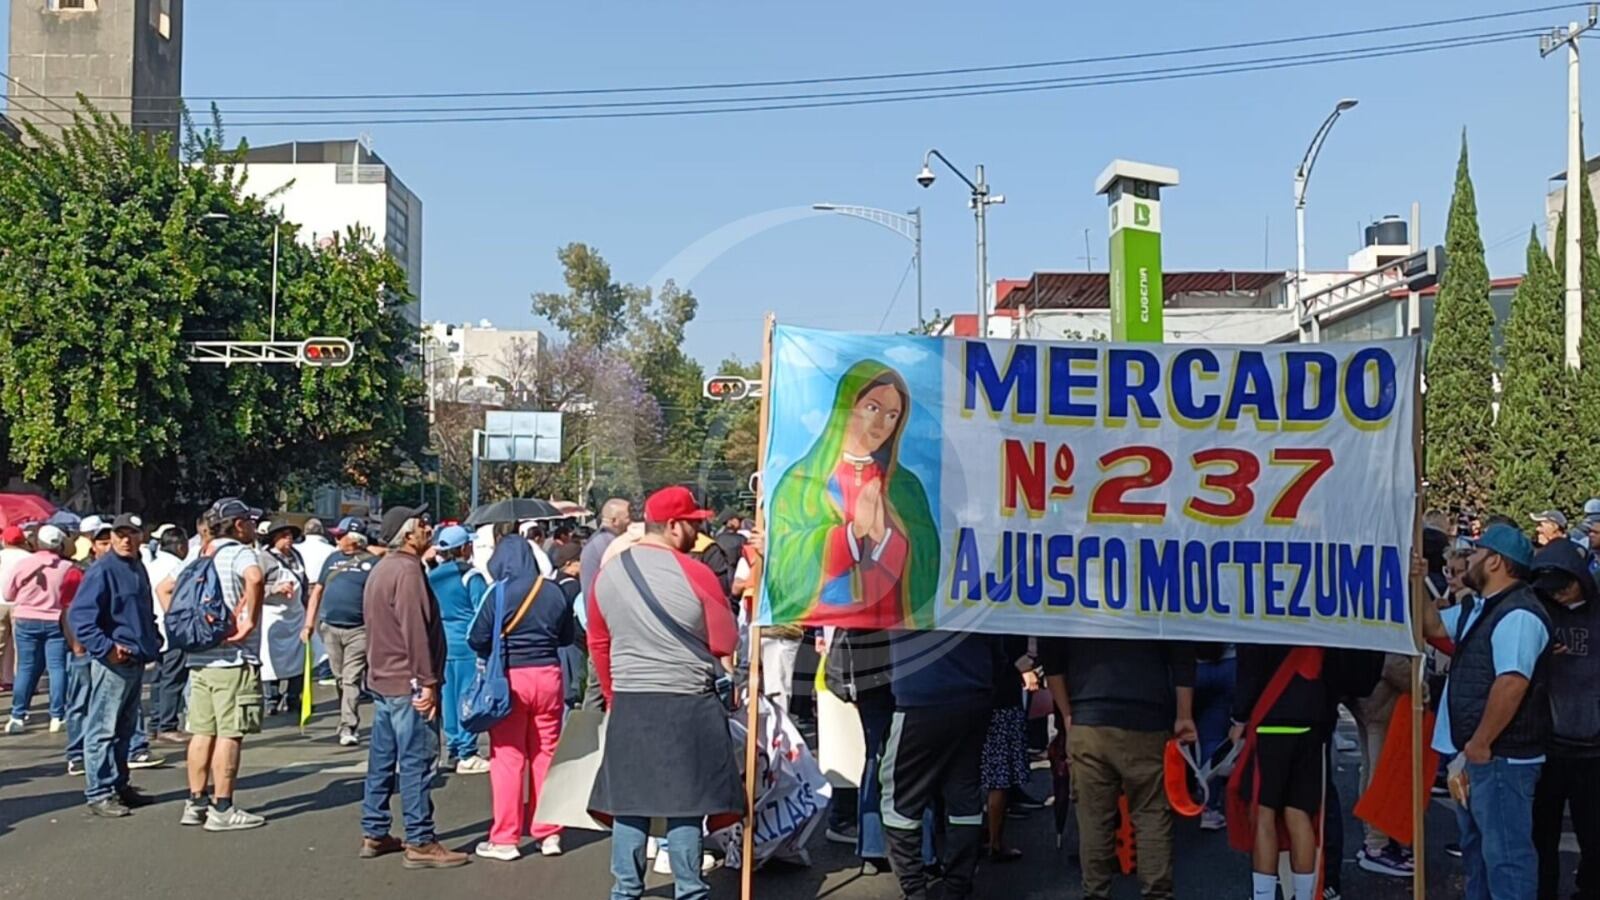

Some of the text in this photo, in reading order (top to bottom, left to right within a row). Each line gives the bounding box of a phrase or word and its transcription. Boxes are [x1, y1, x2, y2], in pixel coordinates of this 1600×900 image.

[1139, 267, 1149, 323] EUGENIA
[962, 340, 1398, 430] MERCADO
[1088, 445, 1335, 524] 237
[1138, 537, 1406, 625] MOCTEZUMA
